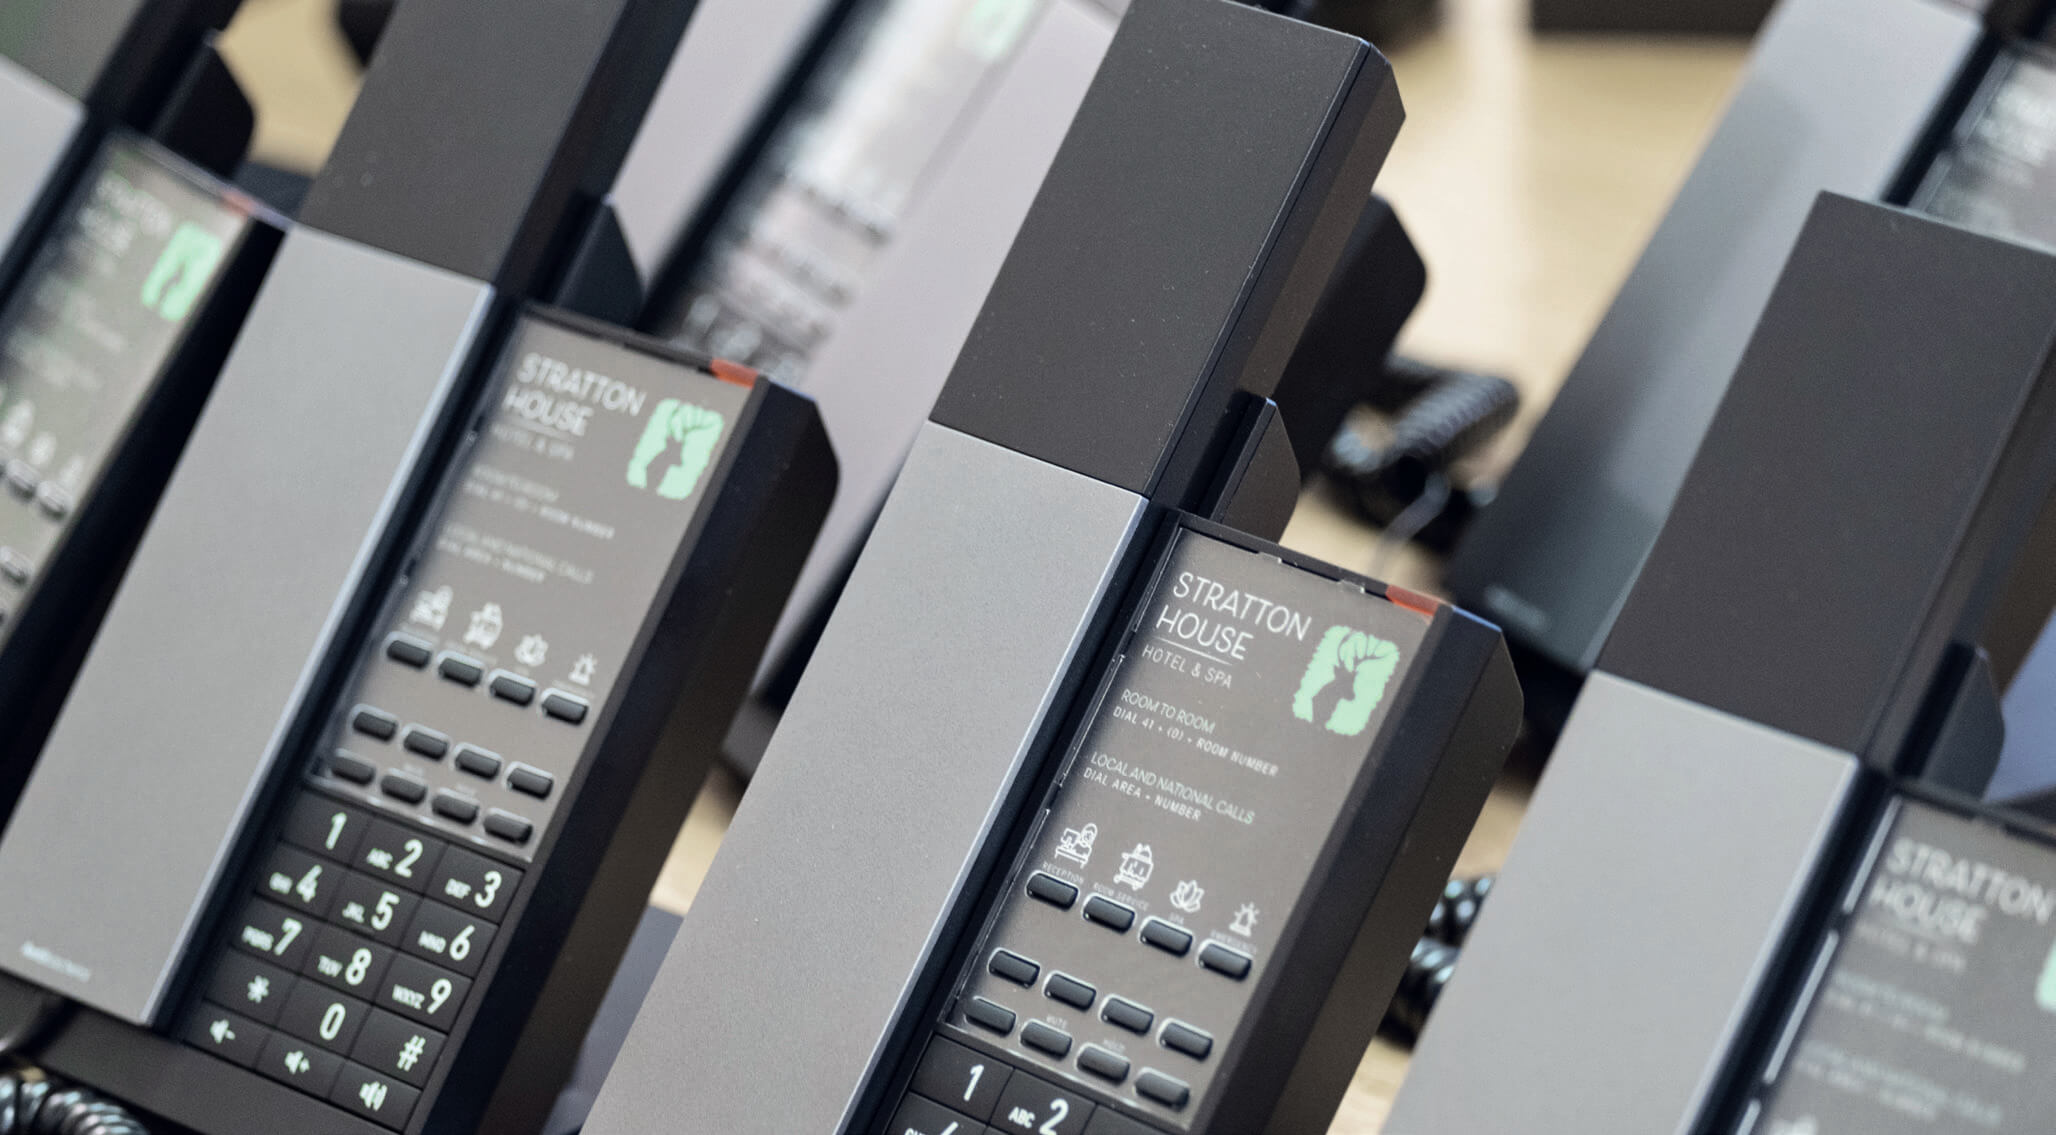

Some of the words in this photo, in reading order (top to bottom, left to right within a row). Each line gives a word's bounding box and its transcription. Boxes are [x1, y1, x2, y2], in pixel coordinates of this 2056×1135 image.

[516, 352, 647, 416] STRATTON
[503, 385, 594, 437] HOUSE
[1173, 572, 1312, 641] STRATTON
[1156, 605, 1254, 660] HOUSE
[1142, 645, 1186, 673] HOTEL
[1191, 664, 1200, 677] &
[1204, 668, 1232, 688] SPA
[1121, 689, 1159, 713] ROOM
[1160, 702, 1176, 718] TO
[1176, 709, 1216, 734] ROOM
[1113, 706, 1137, 724] DIAL
[1142, 718, 1154, 730] 41
[1196, 737, 1229, 758] ROOM
[1231, 751, 1279, 777] NUMBER
[1084, 768, 1108, 786] DIAL
[1112, 779, 1141, 798] AREA
[1154, 795, 1201, 821] NUMBER
[1091, 752, 1129, 776] LOCAL
[1130, 768, 1156, 786] AND
[1156, 777, 1213, 810] NATIONAL
[1216, 800, 1255, 825] CALLS
[325, 812, 347, 850] 1
[394, 839, 423, 878] 2
[296, 864, 323, 903] 4
[474, 870, 502, 908] 3
[1885, 837, 2056, 926] STRATTON
[371, 891, 400, 930] 5
[1867, 873, 1987, 946] HOUSE
[273, 917, 302, 956] 7
[449, 924, 475, 961] 6
[345, 948, 372, 985] 8
[427, 978, 452, 1014] 9
[319, 1002, 346, 1041] 0
[963, 1064, 984, 1101] 1
[1008, 1106, 1035, 1128] ABC
[1039, 1098, 1069, 1135] 2
